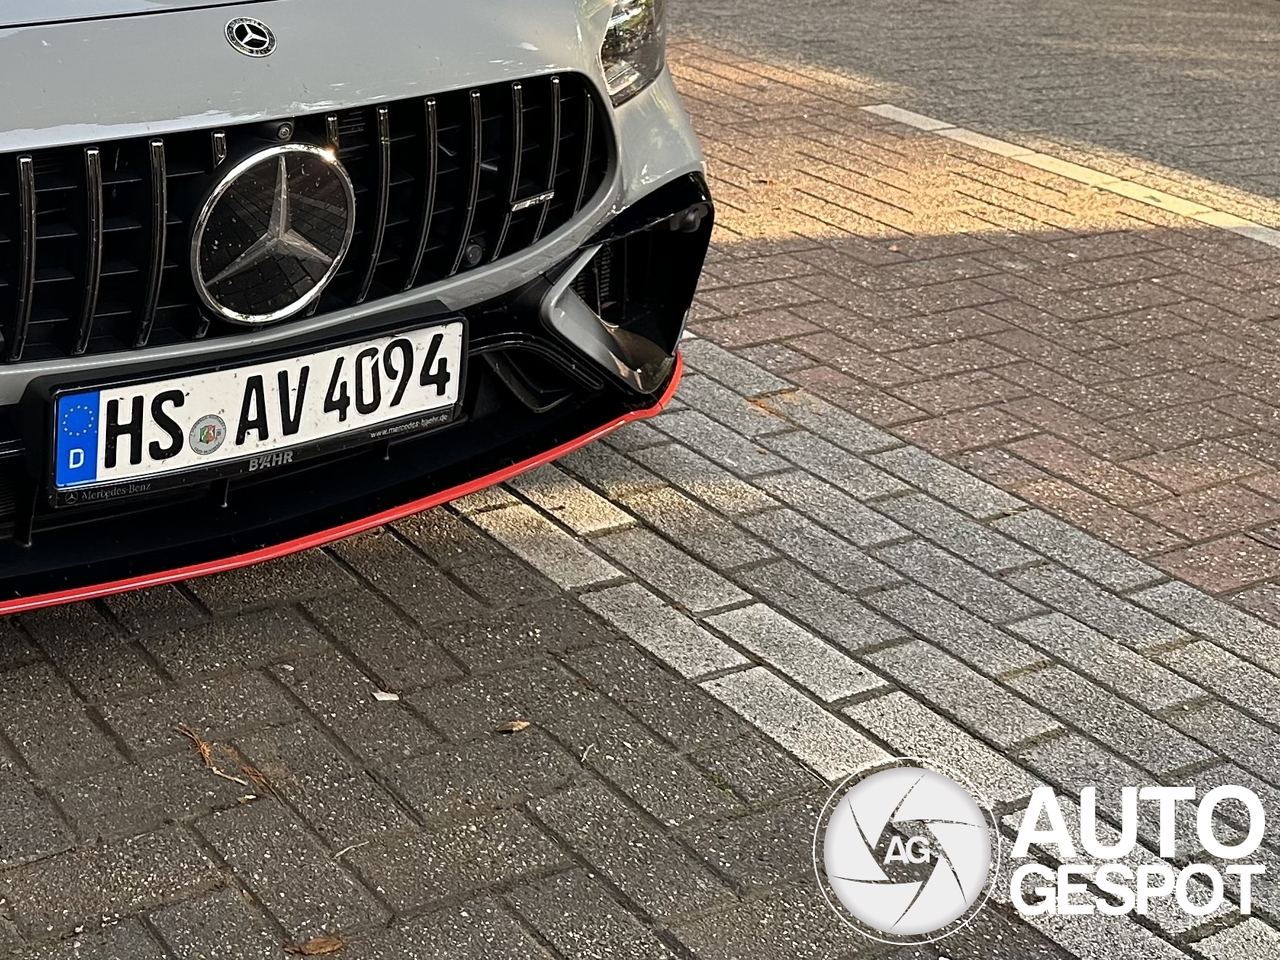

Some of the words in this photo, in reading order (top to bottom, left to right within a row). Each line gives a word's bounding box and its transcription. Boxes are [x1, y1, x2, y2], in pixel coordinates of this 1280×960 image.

[104, 389, 185, 469] HS
[235, 365, 310, 446] AV
[323, 333, 451, 423] 4094
[69, 448, 85, 469] D
[81, 482, 152, 500] Mercedes-Benz
